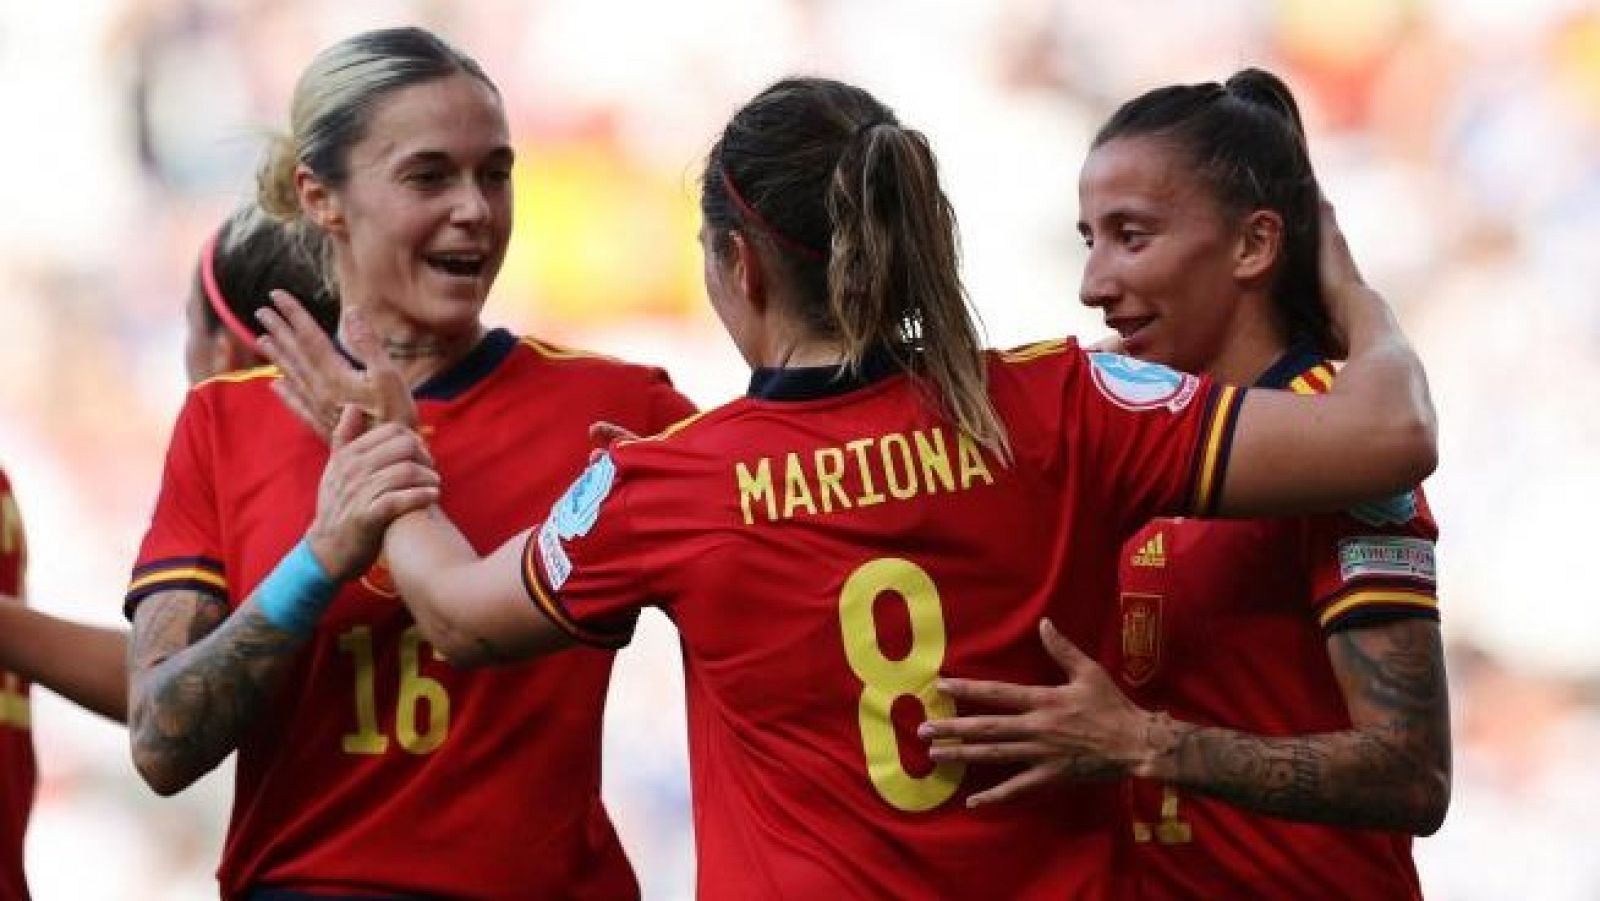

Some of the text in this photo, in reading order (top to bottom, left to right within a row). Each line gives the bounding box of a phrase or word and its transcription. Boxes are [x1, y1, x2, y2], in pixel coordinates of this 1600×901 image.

[735, 428, 994, 525] MARIONA
[338, 625, 449, 754] 16
[838, 557, 965, 811] 8
